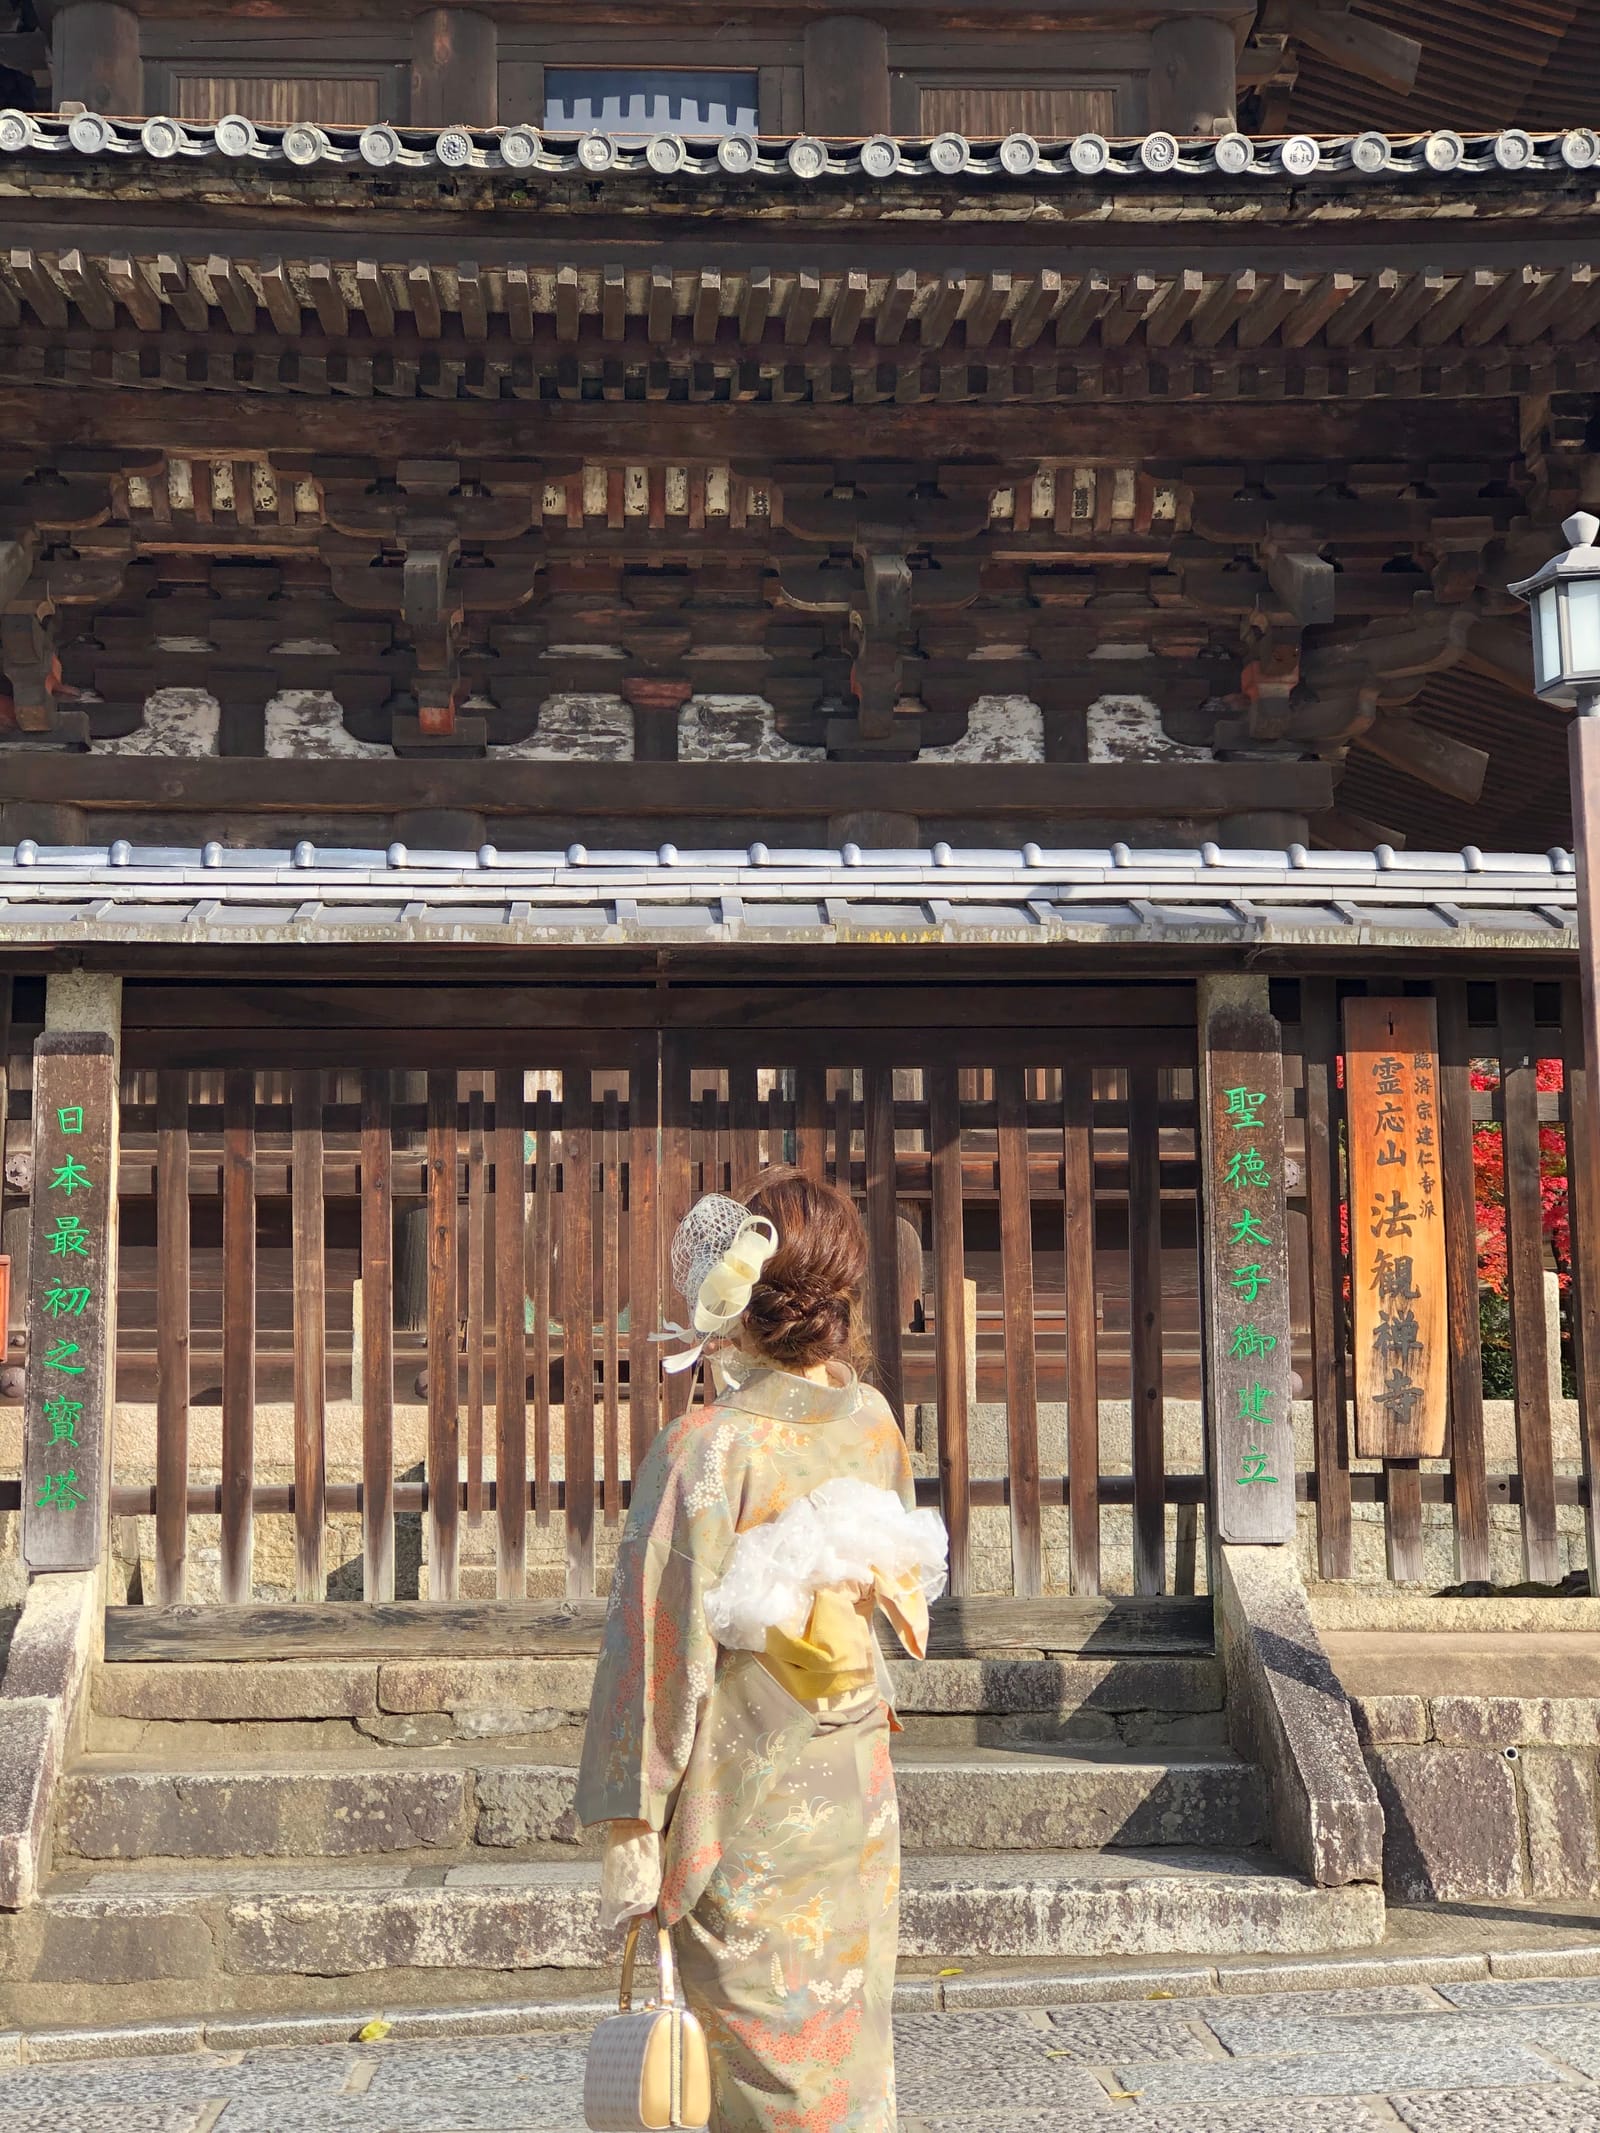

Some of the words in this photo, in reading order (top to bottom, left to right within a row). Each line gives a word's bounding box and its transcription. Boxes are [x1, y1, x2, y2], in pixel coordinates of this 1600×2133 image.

[1414, 1052, 1437, 1220] 臨済宗建仁寺派
[1223, 1086, 1277, 1485] 聖徳太子御建立
